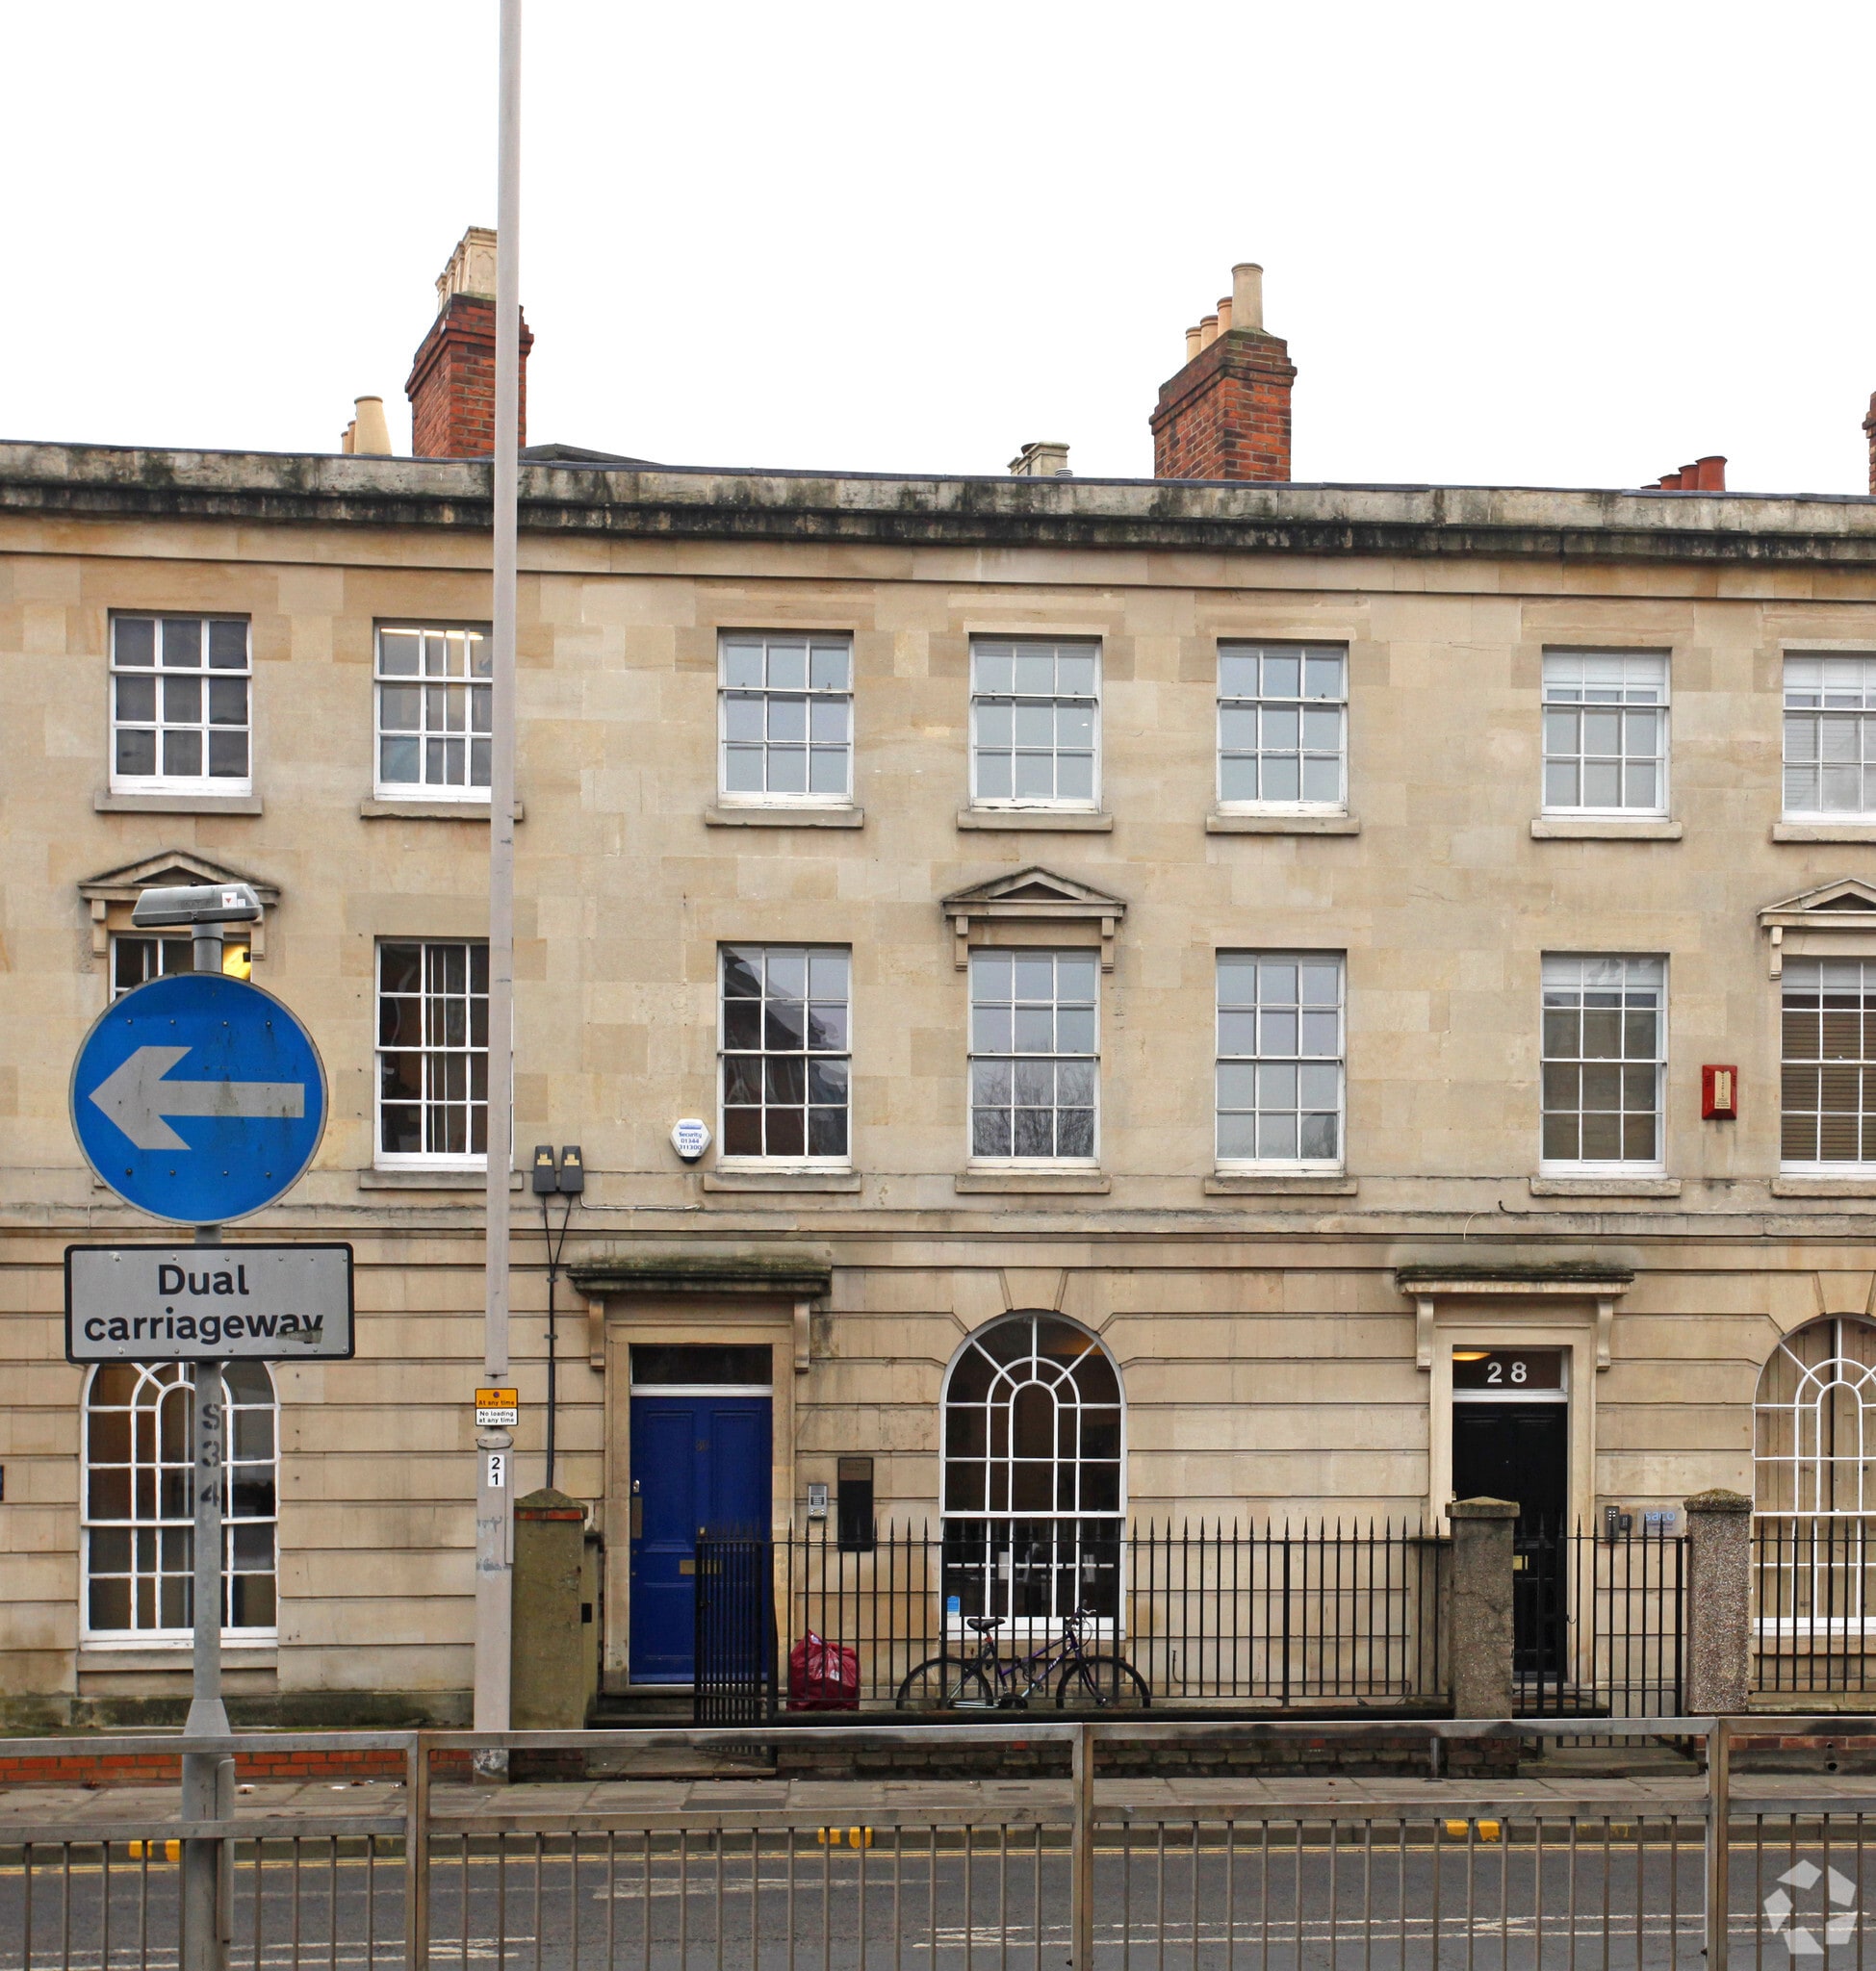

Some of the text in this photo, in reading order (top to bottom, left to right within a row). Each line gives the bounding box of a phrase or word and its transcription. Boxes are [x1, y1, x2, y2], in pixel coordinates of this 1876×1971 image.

[159, 1264, 250, 1295] Dual
[84, 1306, 323, 1345] carriageway
[1486, 1361, 1528, 1384] 28
